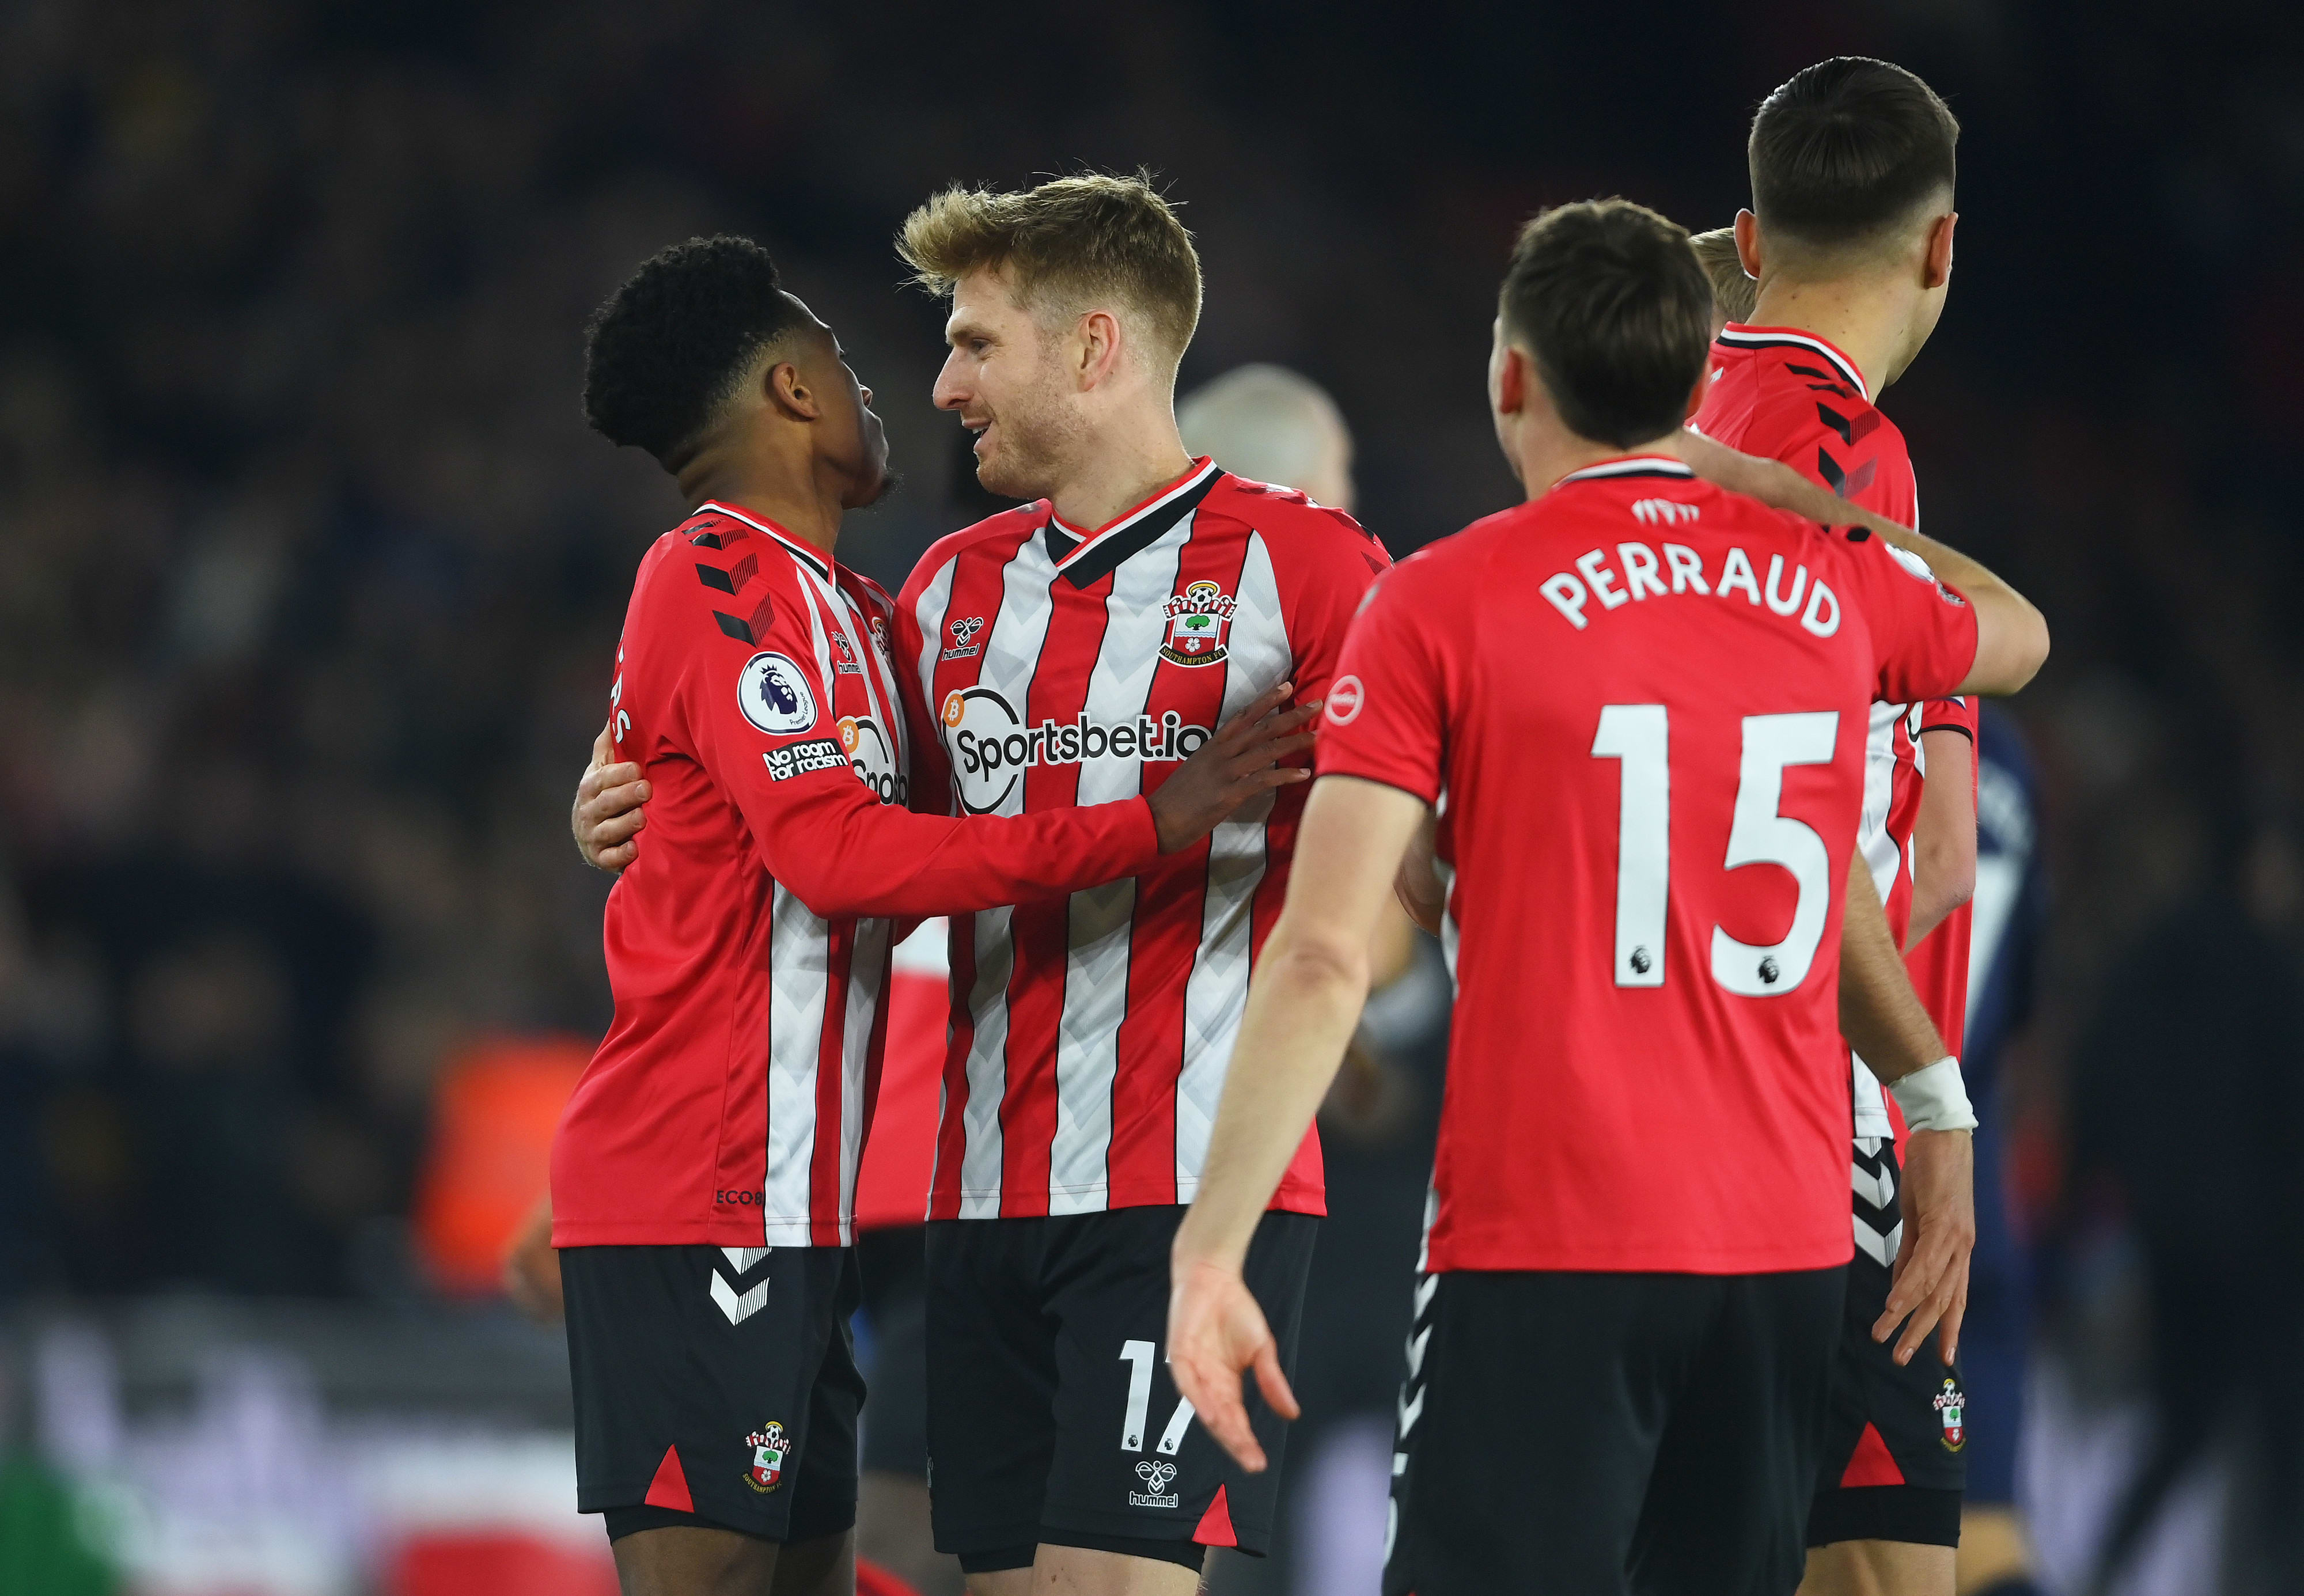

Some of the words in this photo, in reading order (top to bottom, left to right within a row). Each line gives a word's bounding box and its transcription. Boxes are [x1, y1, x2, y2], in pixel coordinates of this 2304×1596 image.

[1540, 542, 1840, 638] PERRAUD
[942, 643, 980, 661] hummel
[1162, 647, 1212, 665] SOUTHAMPTON
[1213, 649, 1224, 659] FC
[789, 714, 806, 725] Premier
[800, 691, 809, 714] League
[762, 750, 791, 768] No
[793, 742, 836, 759] room
[957, 713, 1208, 782] Sportsbet.io
[768, 763, 794, 781] for
[797, 754, 848, 773] racism
[1591, 704, 1839, 997] 15
[1130, 1491, 1178, 1508] hummel
